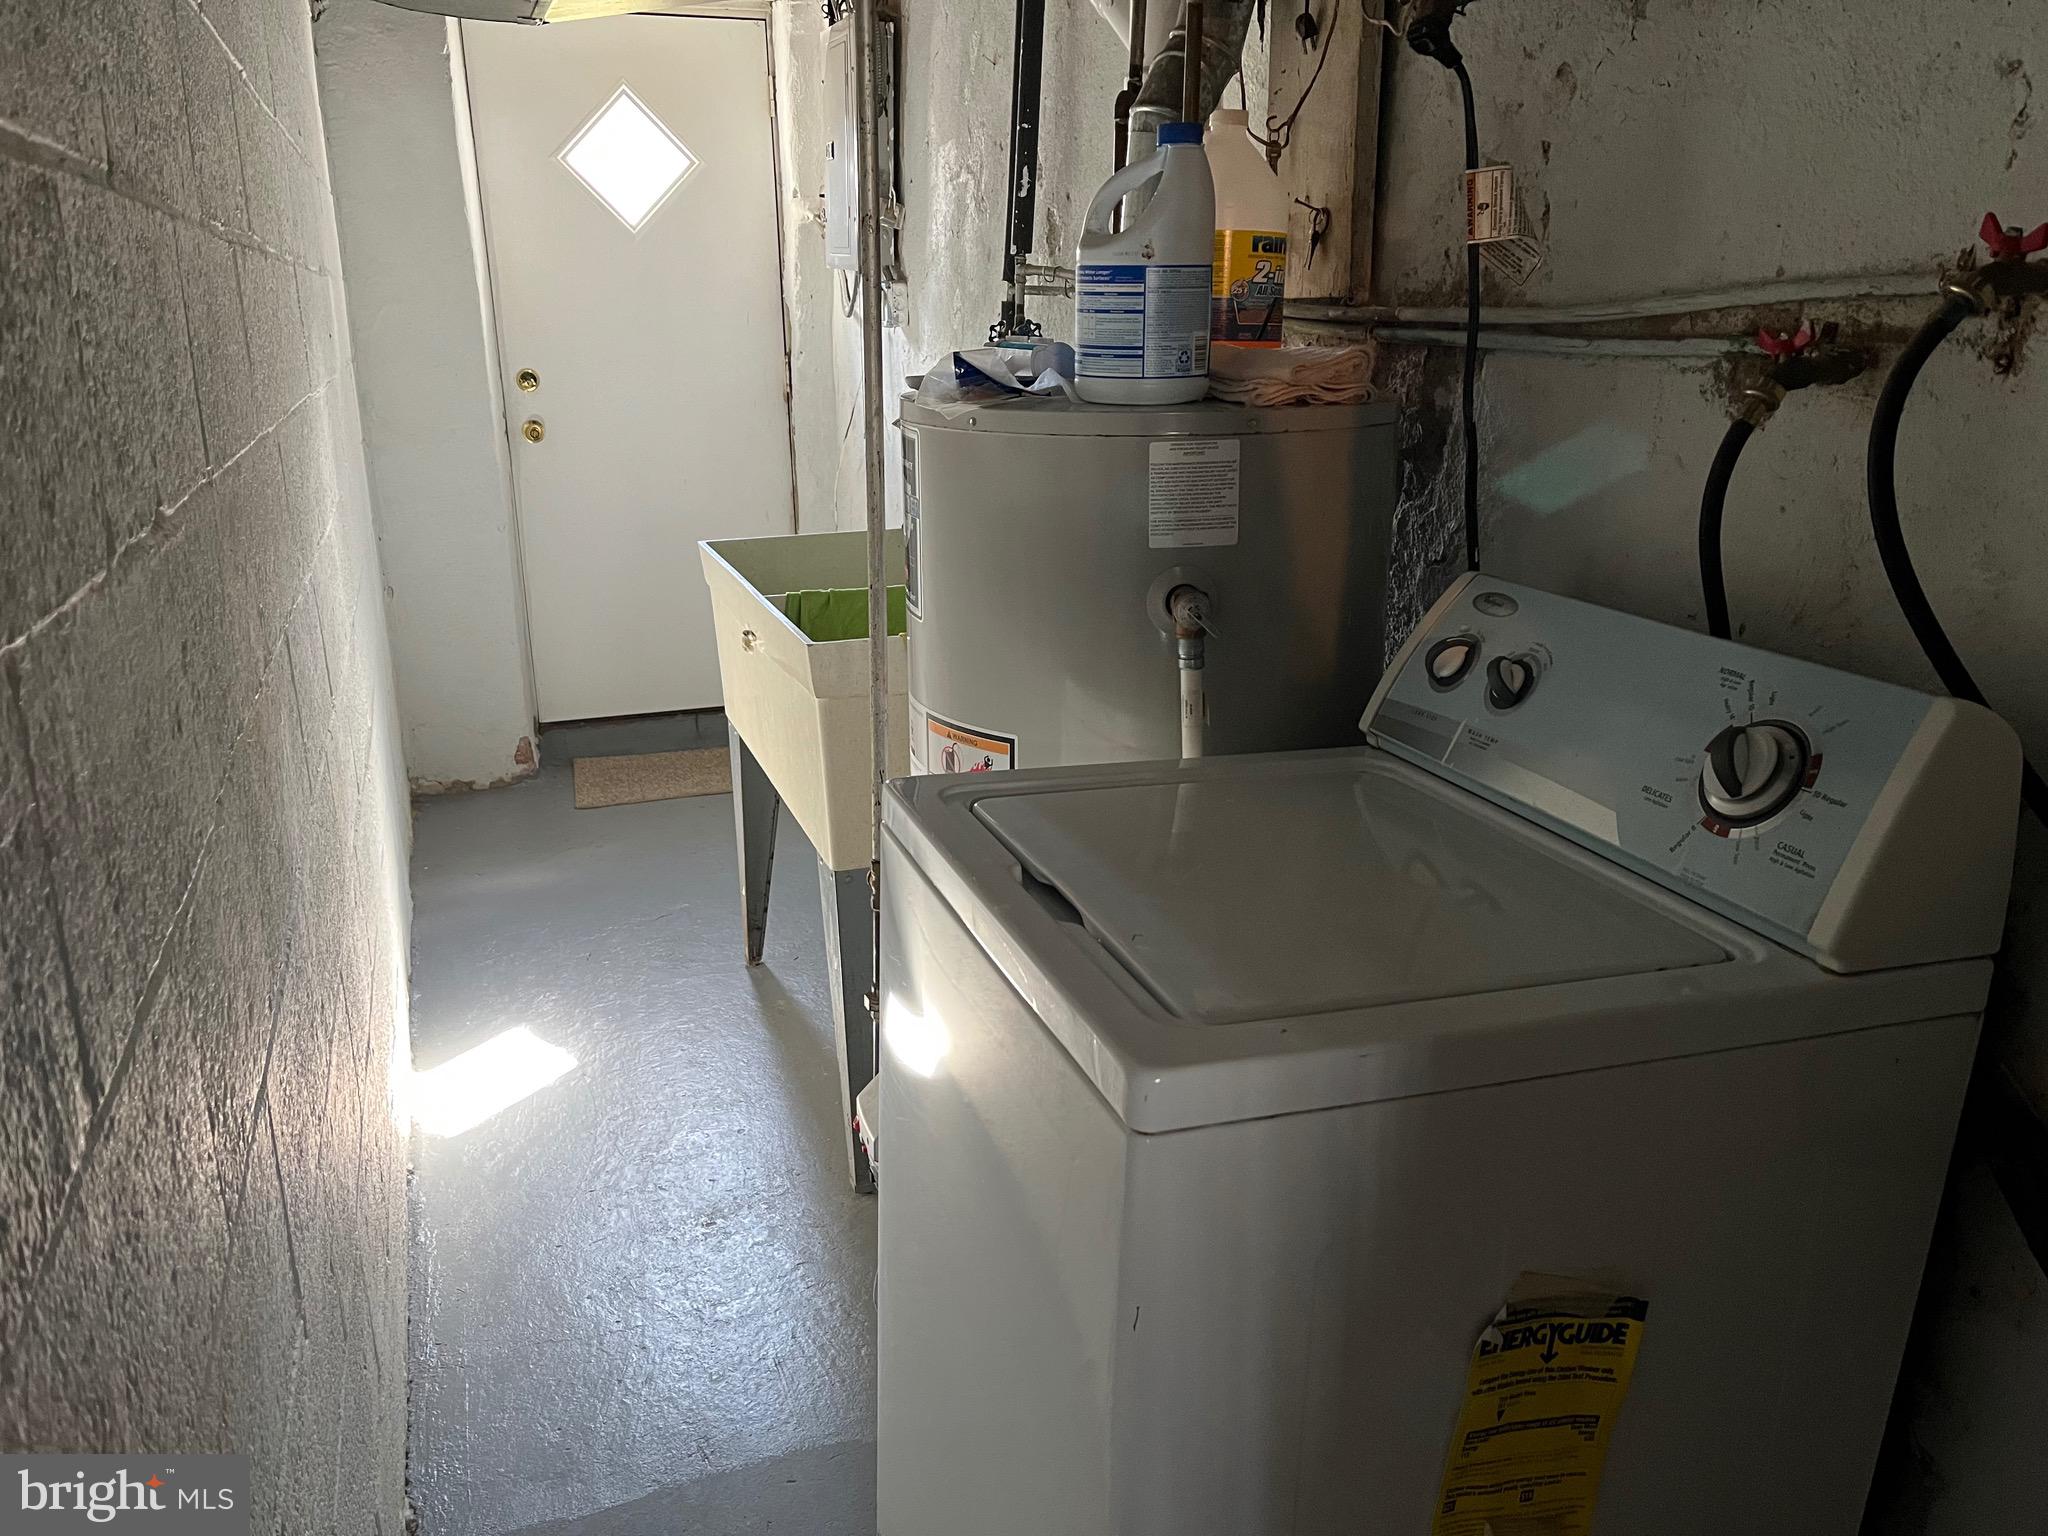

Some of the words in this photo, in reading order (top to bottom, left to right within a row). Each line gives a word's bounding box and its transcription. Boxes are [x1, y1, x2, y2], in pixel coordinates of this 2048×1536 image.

[952, 733, 978, 747] WARNING
[1641, 784, 1673, 804] DELICATES
[1776, 841, 1807, 859] CASUAL
